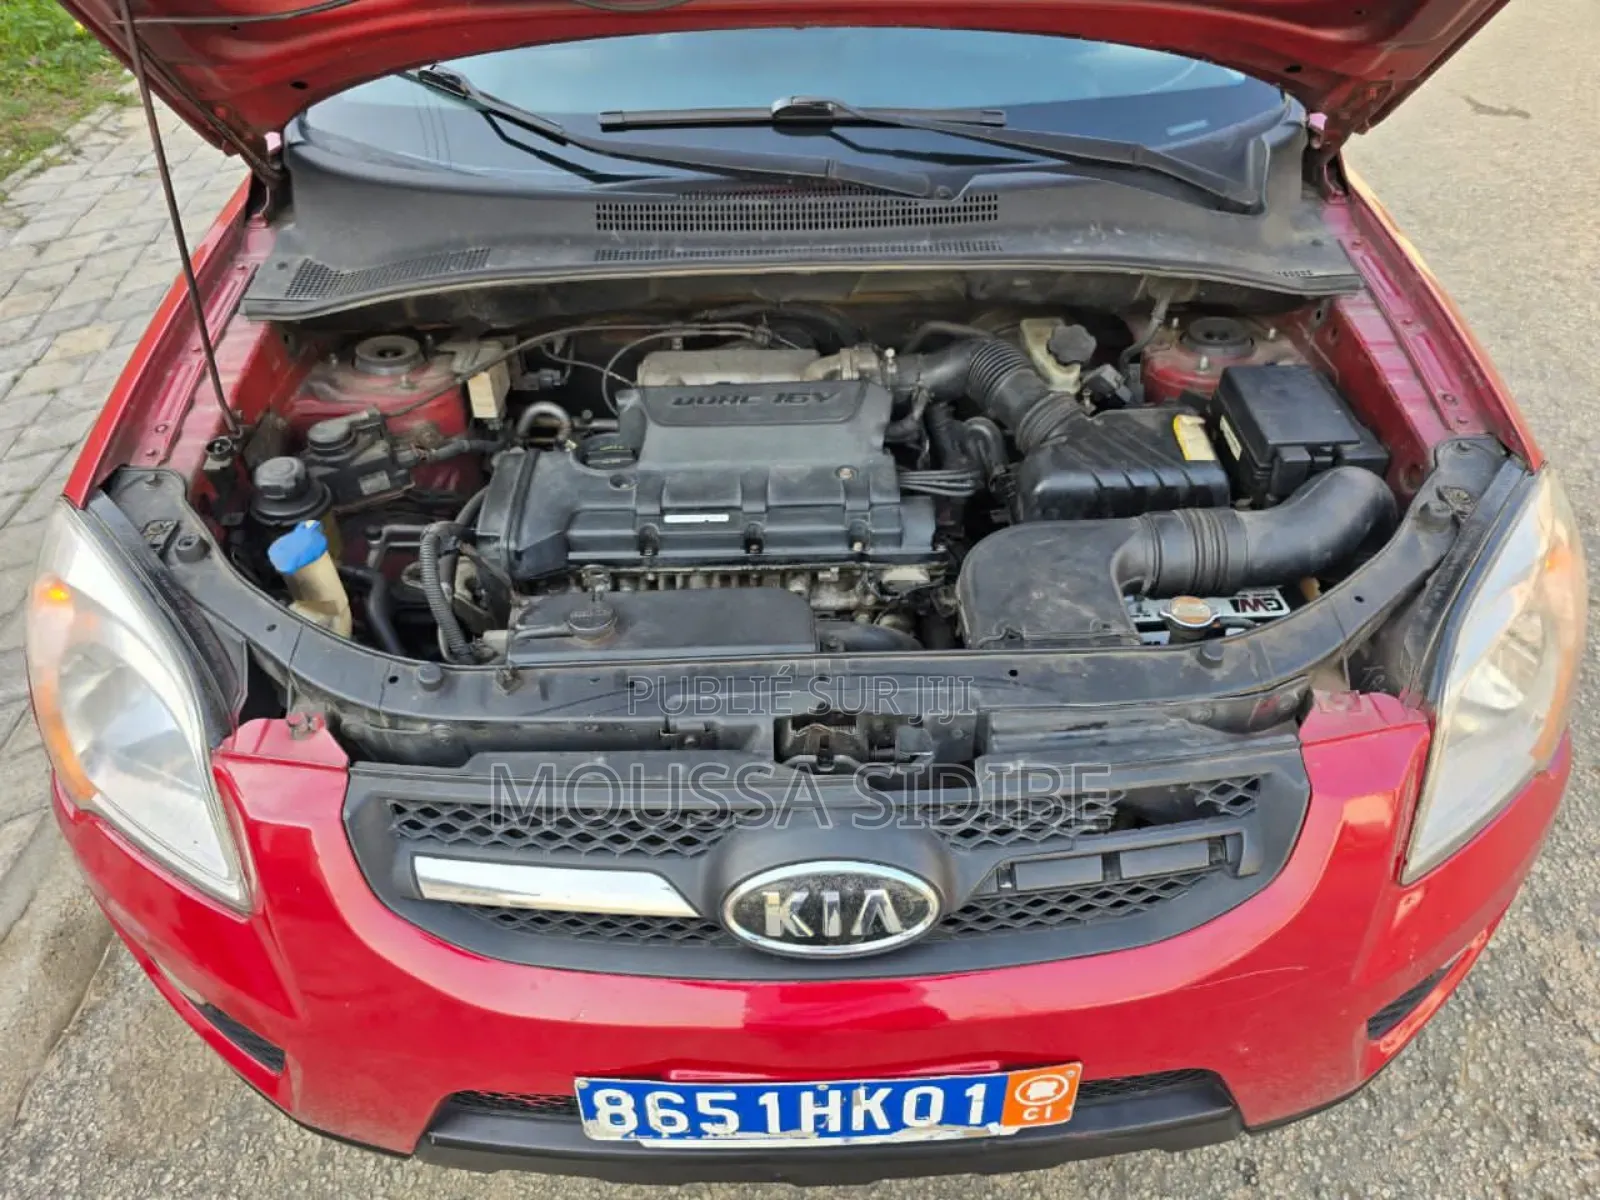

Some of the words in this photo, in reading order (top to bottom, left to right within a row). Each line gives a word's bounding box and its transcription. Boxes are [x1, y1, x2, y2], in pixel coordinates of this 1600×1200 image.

[772, 391, 841, 404] 16V
[762, 889, 904, 937] KIA
[592, 1083, 988, 1134] 8651HK01
[1023, 1104, 1052, 1120] CI
